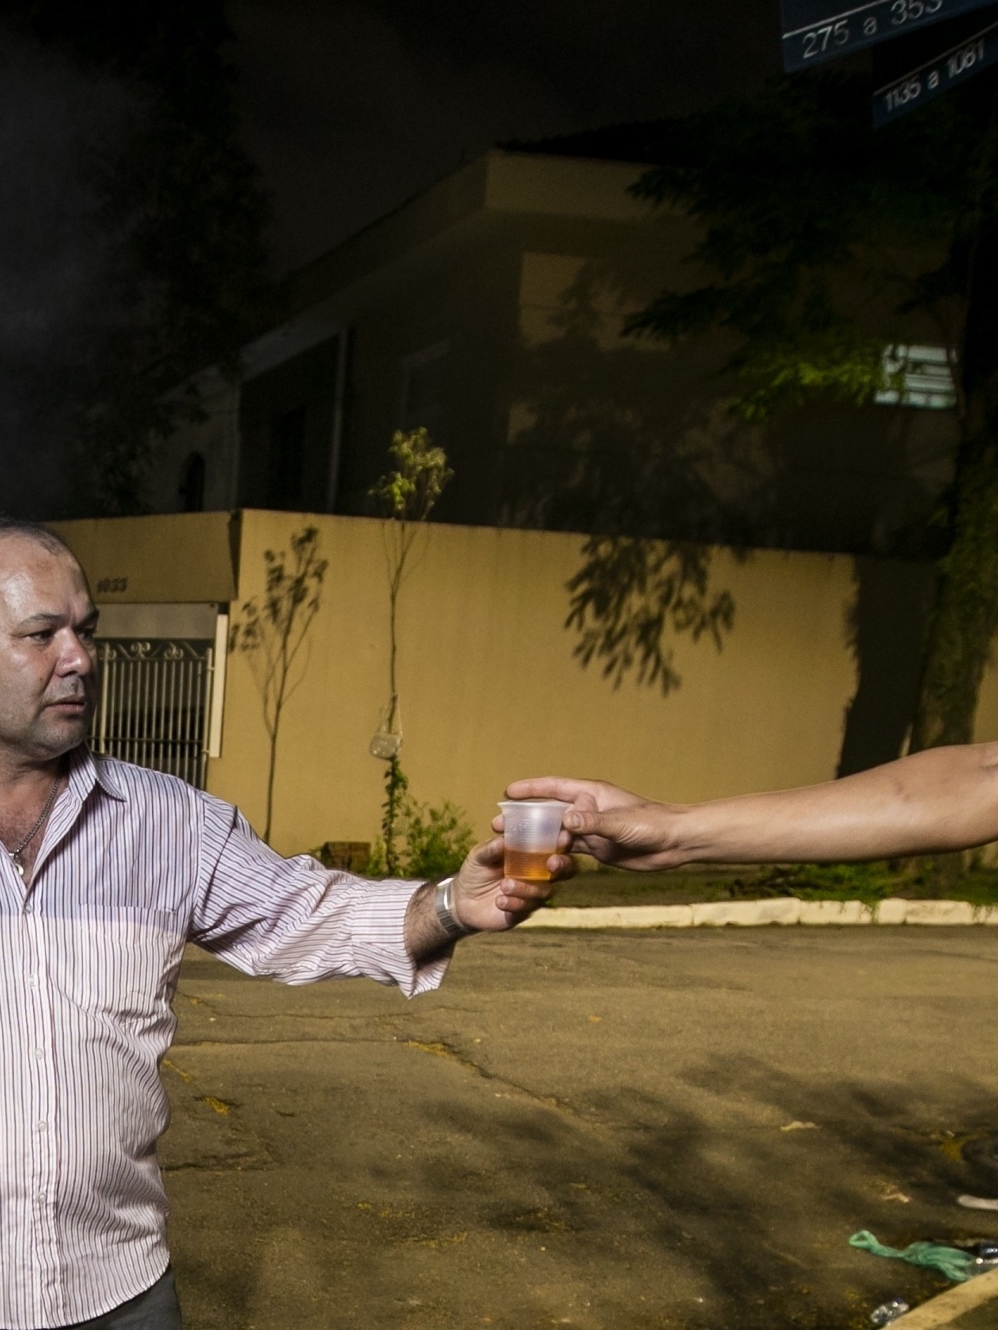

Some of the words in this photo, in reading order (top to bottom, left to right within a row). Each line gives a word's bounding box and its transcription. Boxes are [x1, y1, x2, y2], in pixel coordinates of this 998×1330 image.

[802, 20, 849, 59] 275
[863, 17, 877, 36] a
[884, 76, 921, 112] 1135
[927, 71, 940, 90] a
